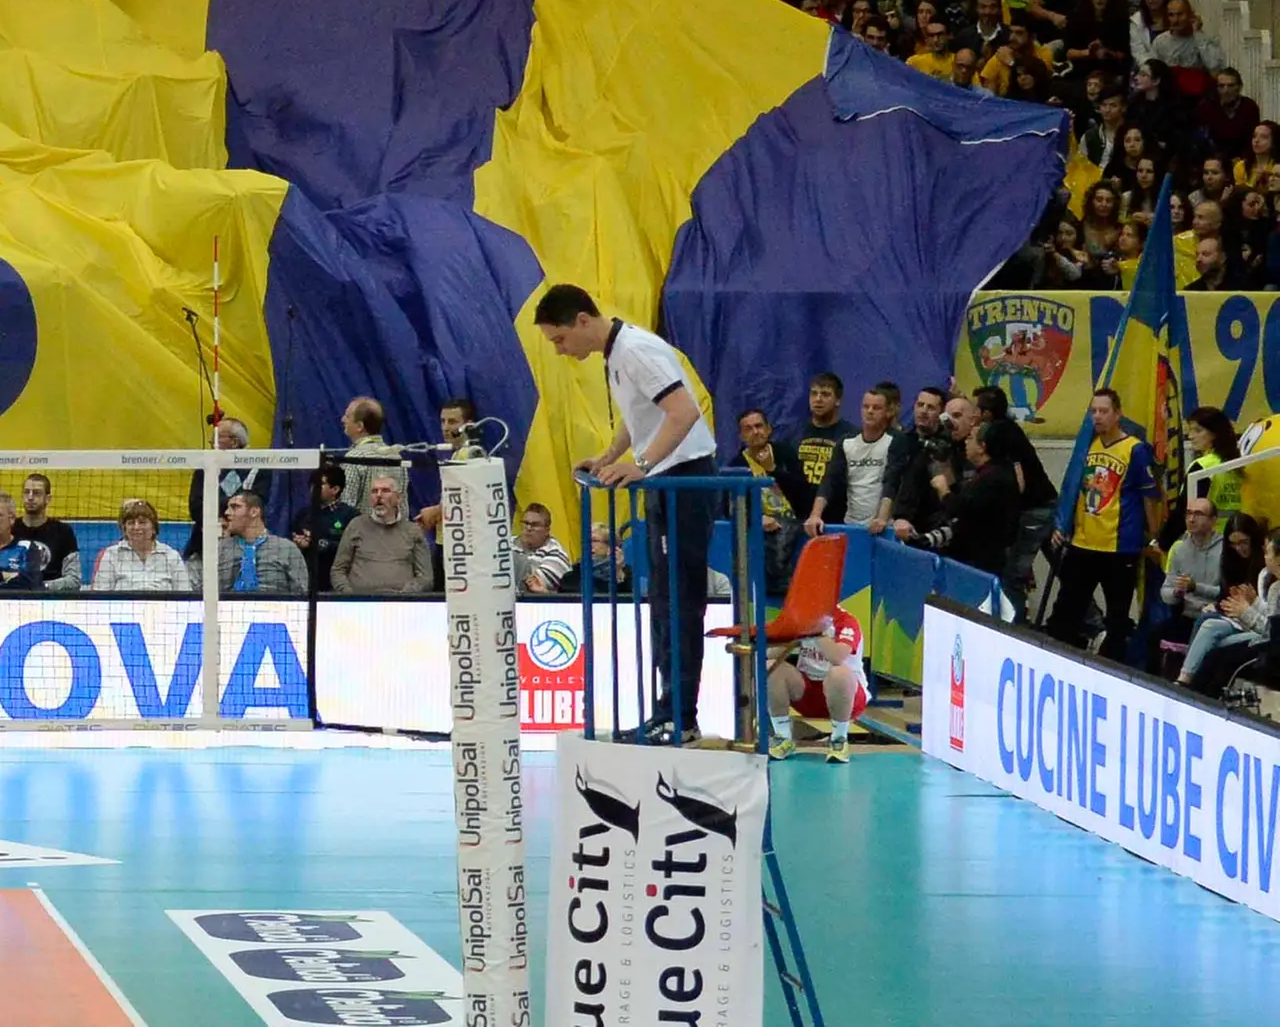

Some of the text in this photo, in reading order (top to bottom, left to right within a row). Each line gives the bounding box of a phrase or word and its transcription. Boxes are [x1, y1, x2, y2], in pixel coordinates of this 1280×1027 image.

[968, 297, 1073, 328] TRENTO
[447, 486, 469, 593] UnipolSai
[452, 613, 474, 721] UnipolSai
[459, 741, 481, 847] UnipolSai
[505, 738, 522, 845] UnipolSai
[997, 657, 1201, 861] CUCINE LUBE
[620, 849, 635, 946] LOGISTICS
